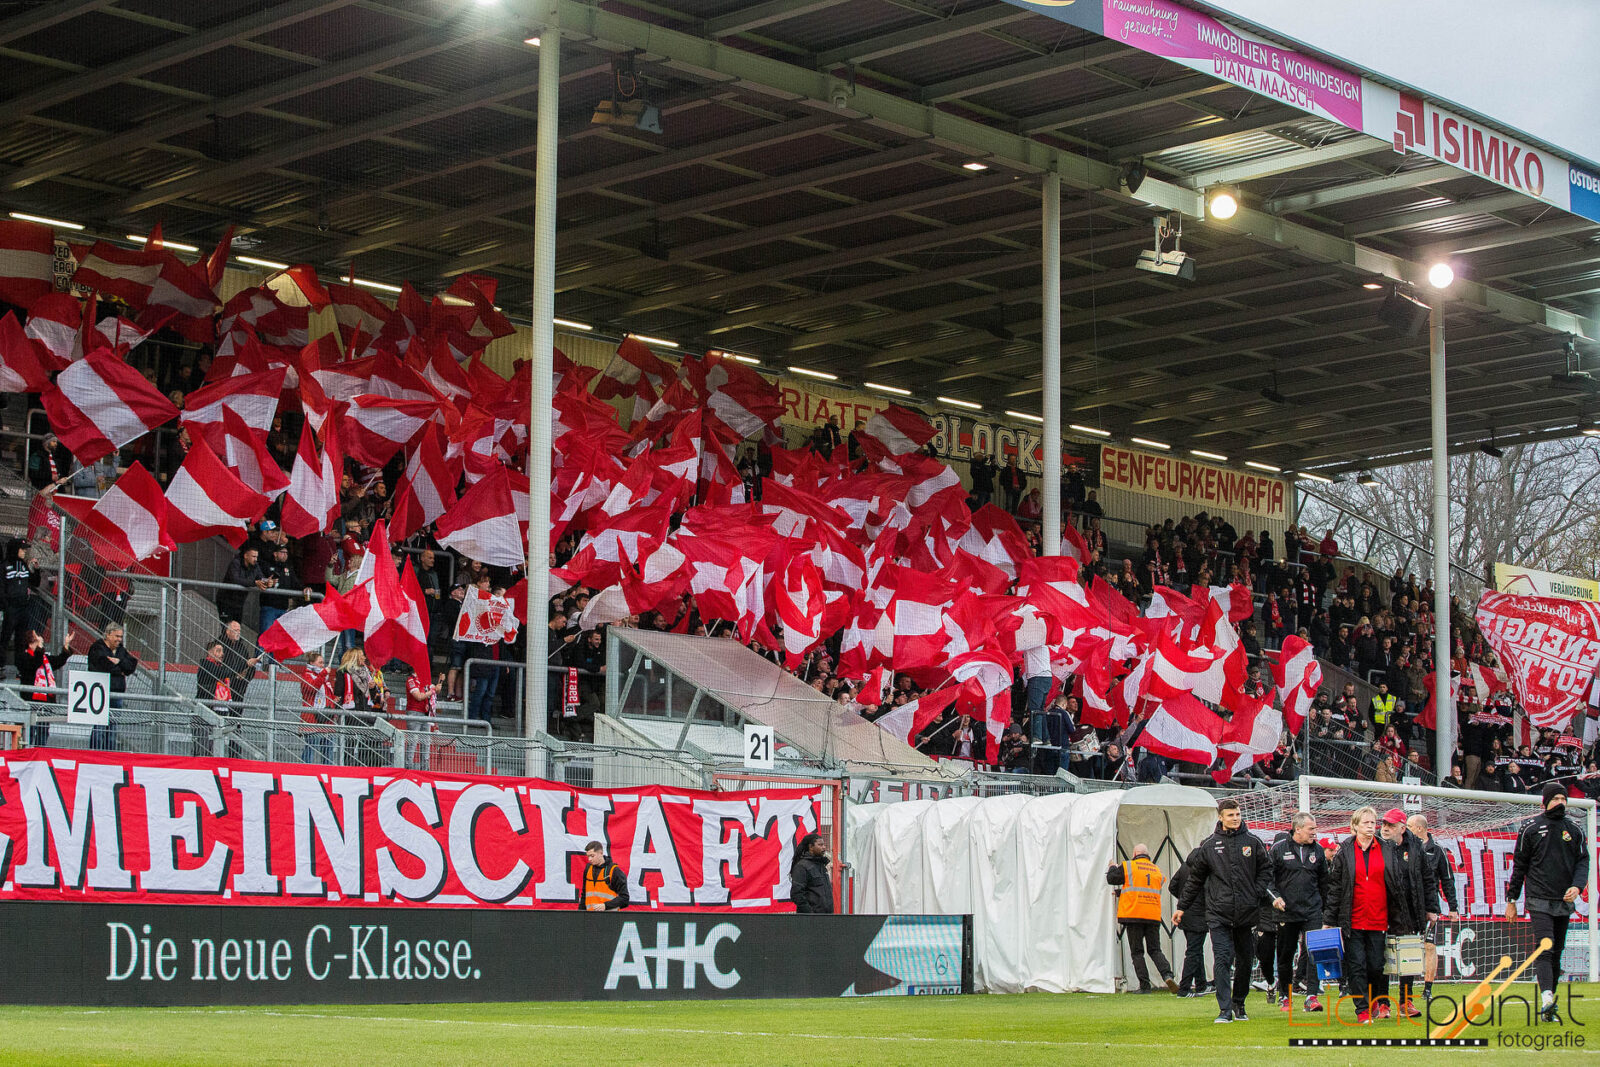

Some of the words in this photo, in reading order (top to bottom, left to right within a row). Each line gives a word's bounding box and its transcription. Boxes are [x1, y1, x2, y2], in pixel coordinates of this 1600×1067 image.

[1197, 22, 1268, 67] IMMOBILIEN
[1272, 52, 1281, 71] &
[1283, 56, 1360, 103] WOHNDESIGN
[1213, 52, 1257, 90] DIANA
[1260, 73, 1315, 111] MAASCH
[1433, 111, 1544, 198] ISIMKO
[1570, 168, 1600, 195] OSTDE
[782, 387, 880, 430] RIATE
[928, 413, 1044, 476] BLOCK
[1102, 447, 1284, 514] SENFGURKENMAFIA
[1549, 580, 1593, 600] VERÄNDERUNG
[73, 681, 105, 715] 20
[750, 733, 769, 761] 21
[0, 759, 822, 904] MEINSCHAFT
[1145, 873, 1151, 886] 1
[106, 922, 178, 981] Die
[191, 937, 292, 981] neue
[304, 923, 482, 981] C-Klasse.
[604, 921, 742, 989] AHC
